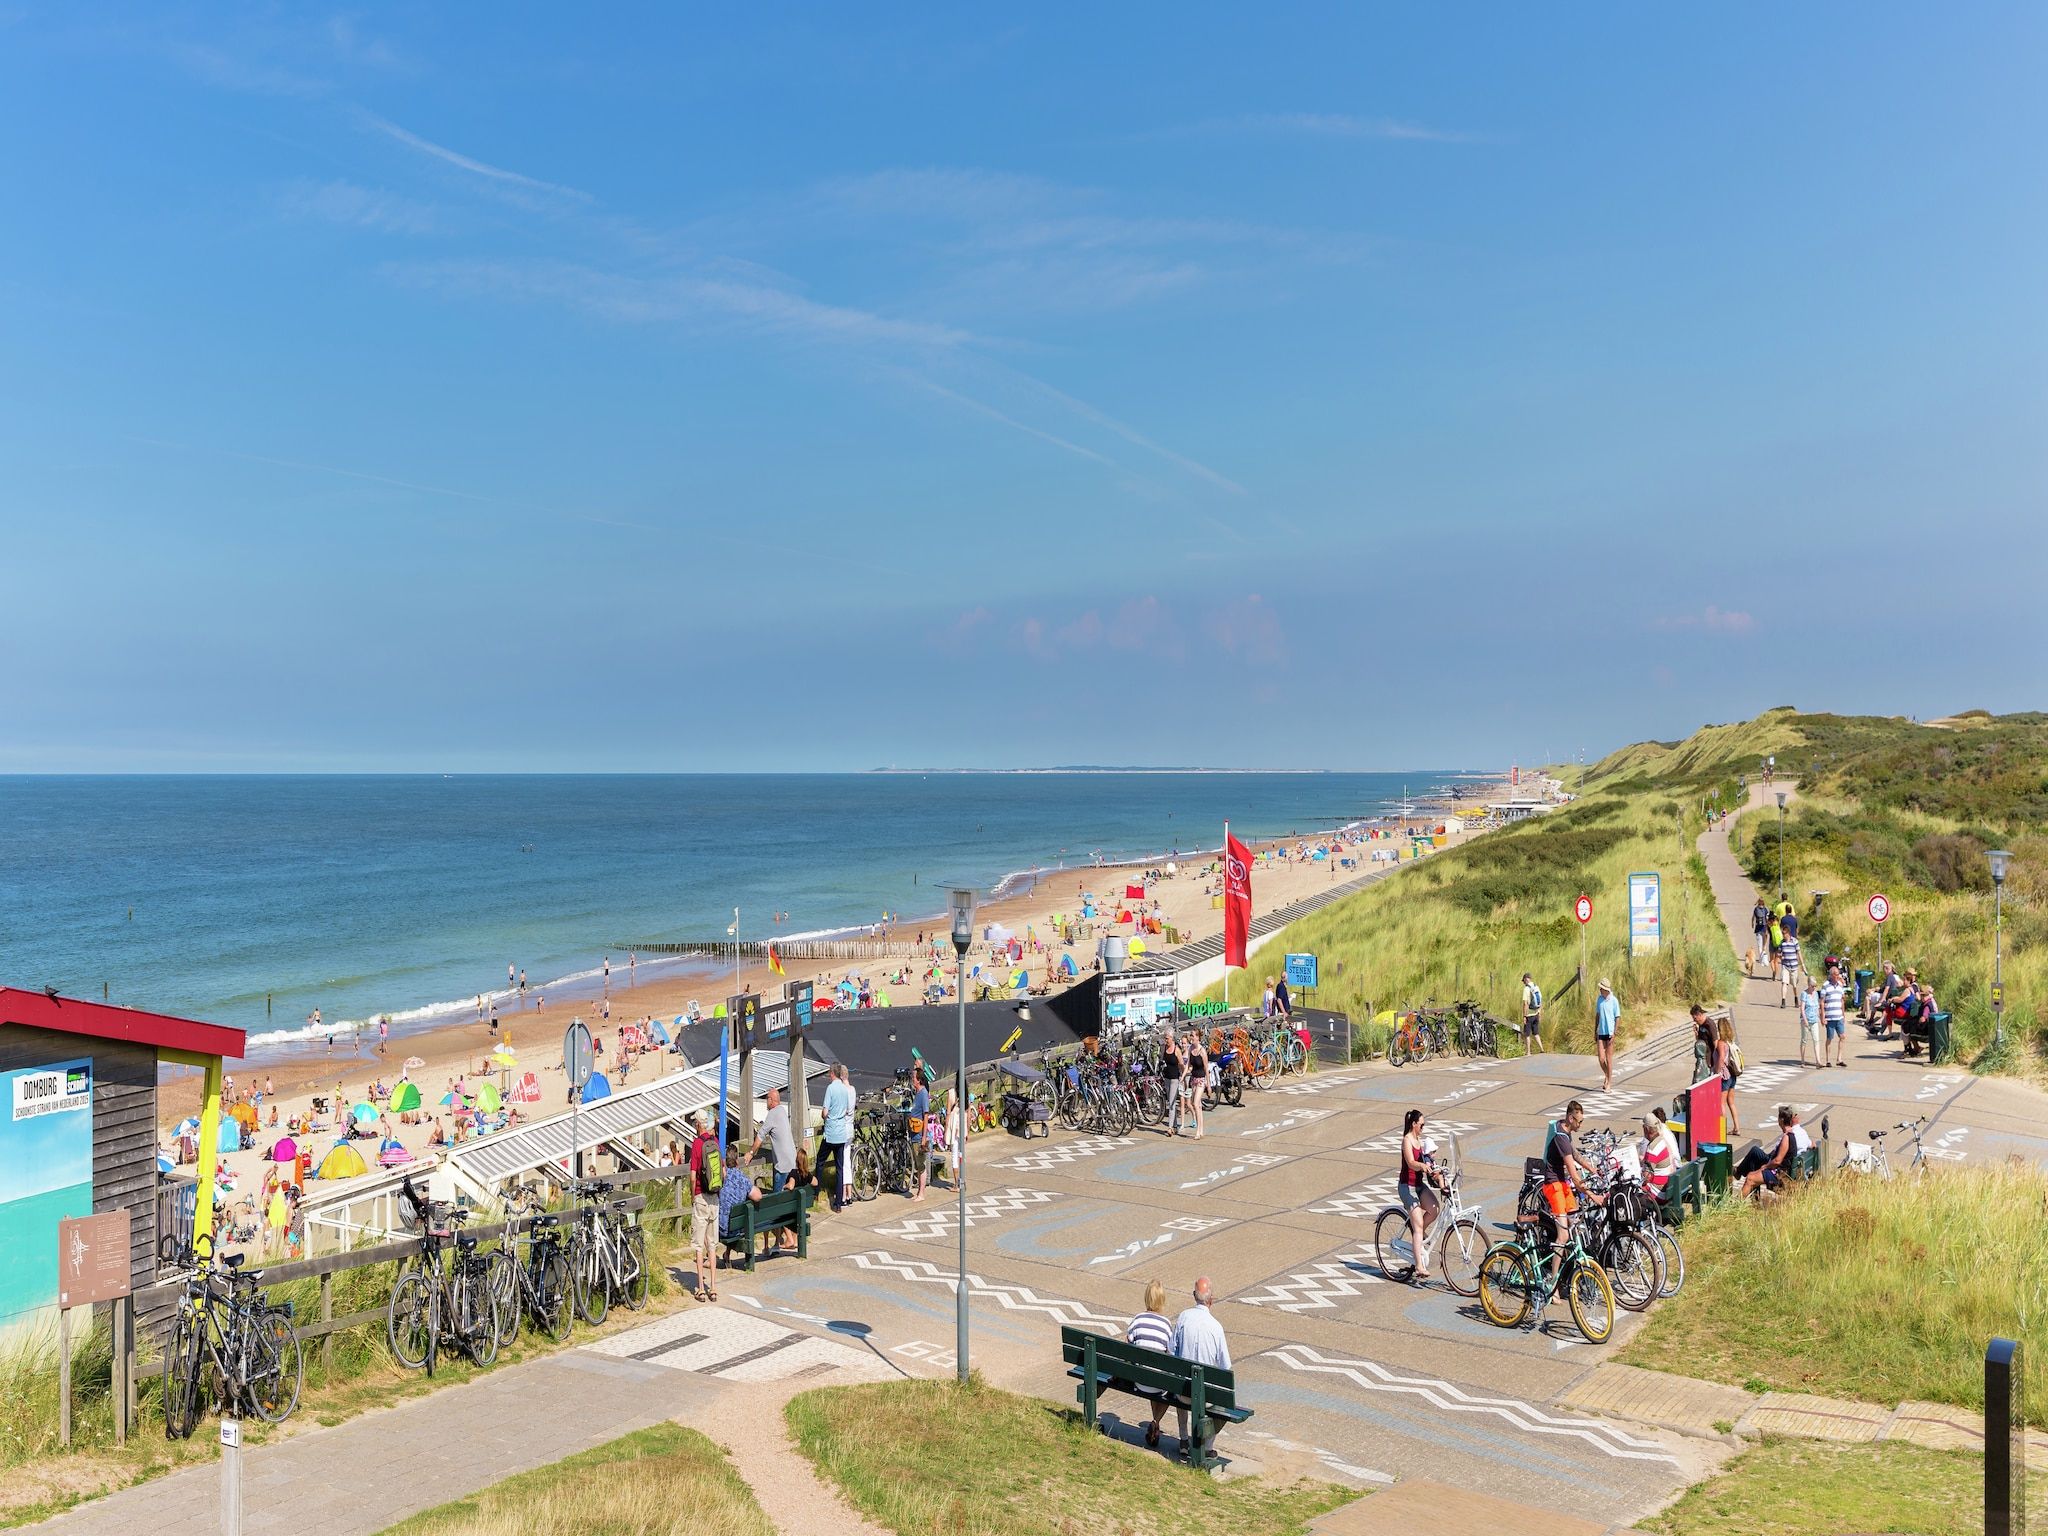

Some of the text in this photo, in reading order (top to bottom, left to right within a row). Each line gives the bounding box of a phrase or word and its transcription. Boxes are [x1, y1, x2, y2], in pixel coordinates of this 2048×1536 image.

[1288, 965, 1312, 975] STENEN
[1296, 974, 1312, 984] TOKO
[765, 1007, 791, 1032] WELKOM
[24, 1076, 57, 1100] DOMBURG
